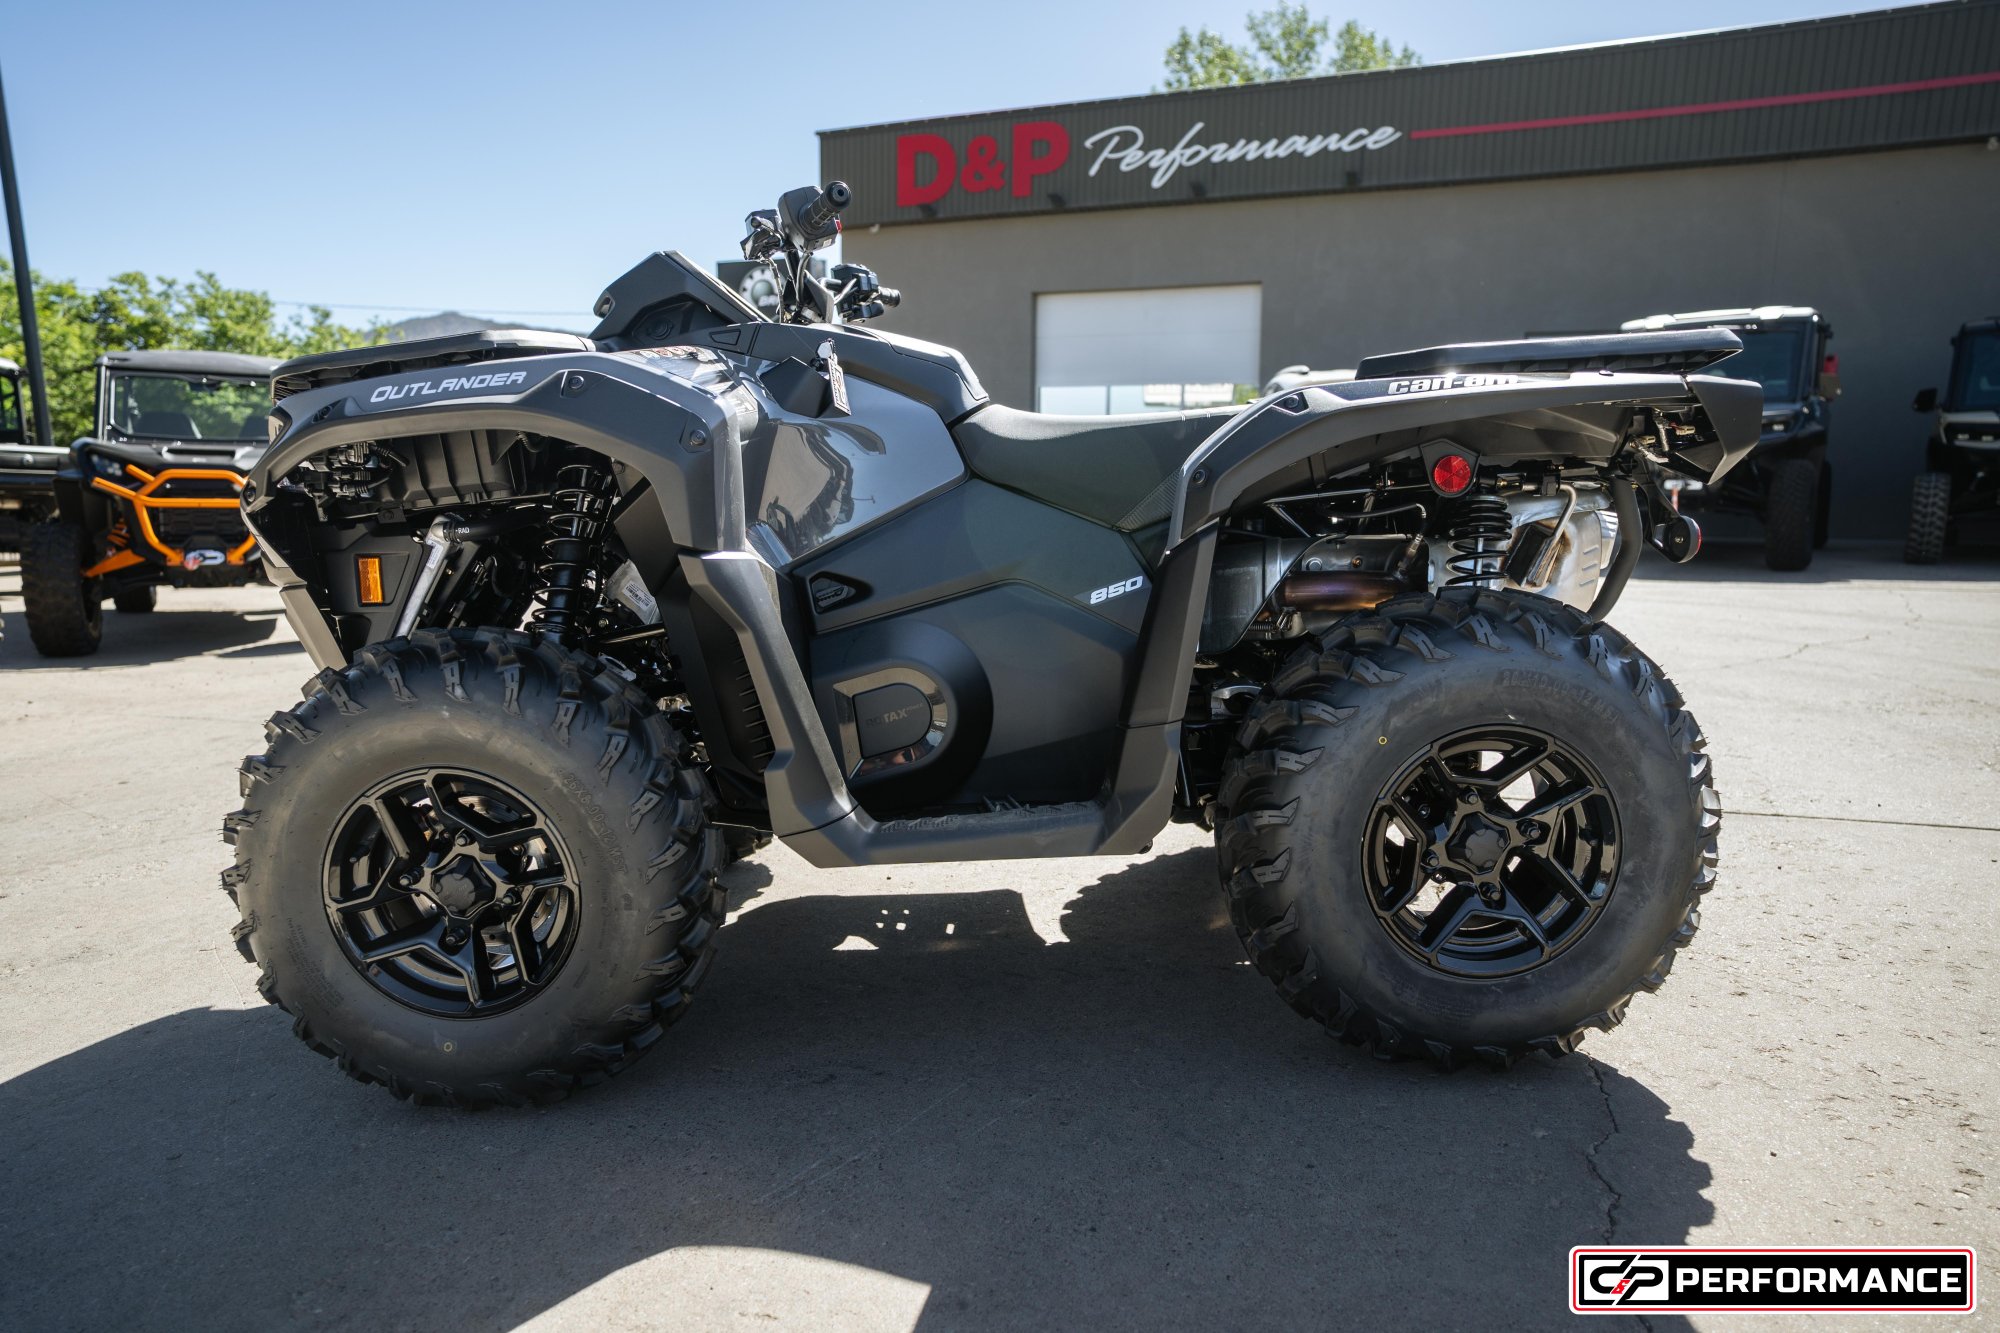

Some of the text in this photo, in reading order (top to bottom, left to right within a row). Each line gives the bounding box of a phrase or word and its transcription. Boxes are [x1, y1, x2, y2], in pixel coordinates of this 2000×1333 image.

[896, 121, 1402, 208] D&P Performance
[370, 371, 527, 403] OUTLANDER
[1387, 374, 1519, 395] can-am
[1089, 575, 1143, 605] 850
